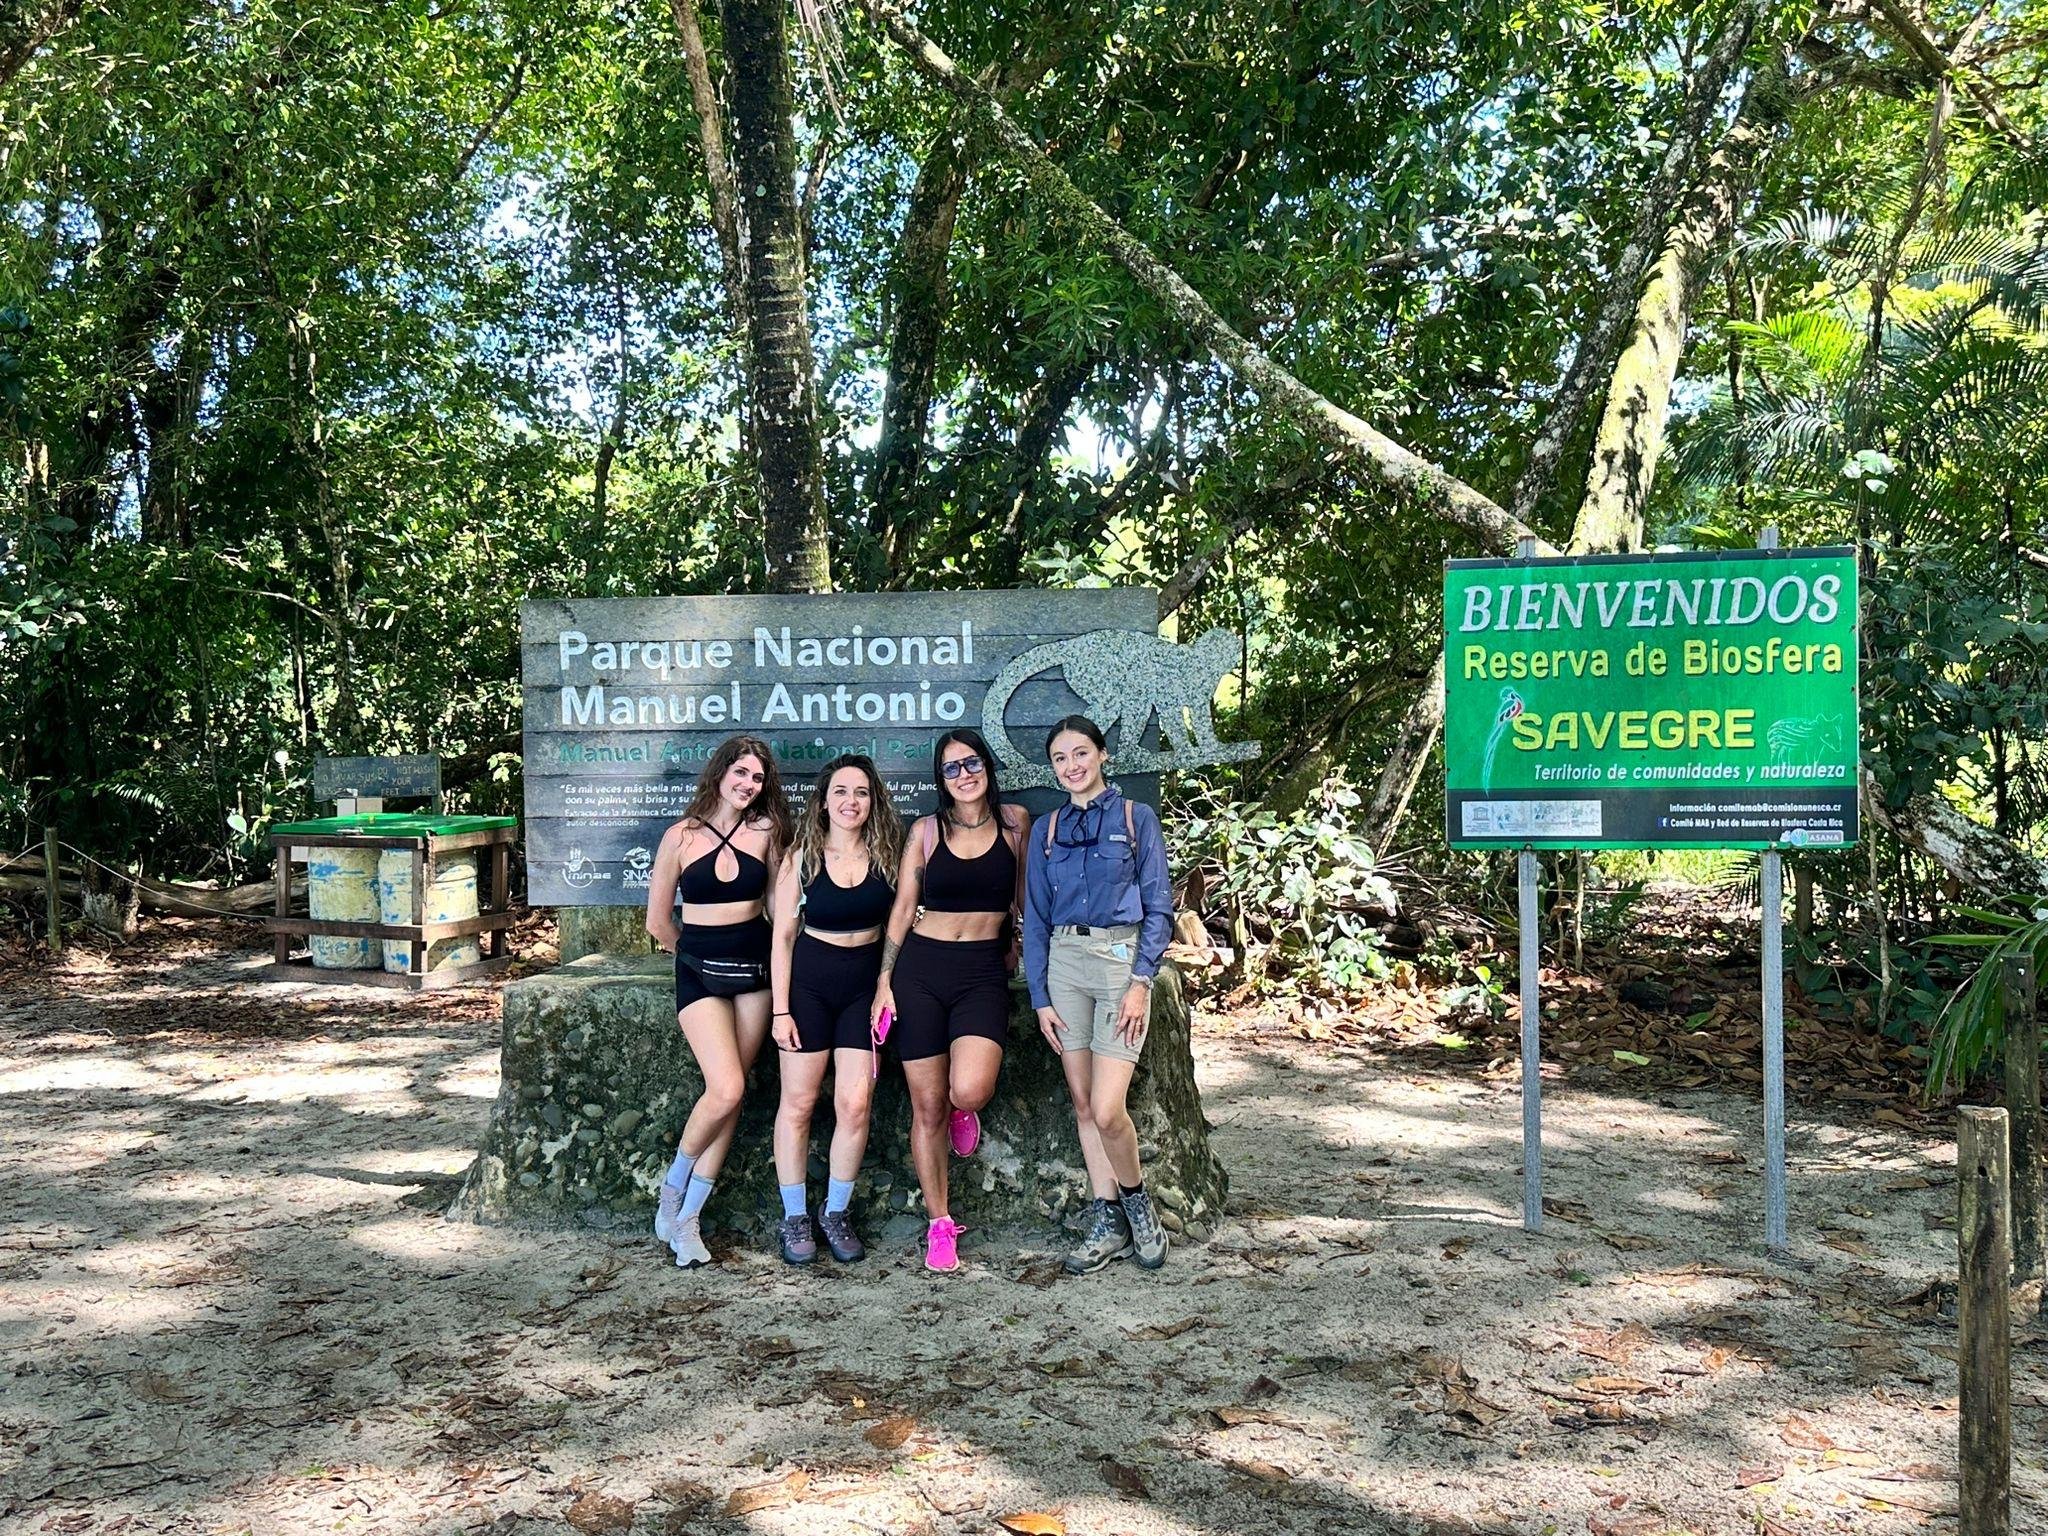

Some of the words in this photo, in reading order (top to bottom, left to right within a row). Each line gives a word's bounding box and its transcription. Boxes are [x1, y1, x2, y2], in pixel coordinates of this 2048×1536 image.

[1459, 574, 1842, 632] BIENVENIDOS
[559, 630, 733, 681] Parque
[753, 620, 973, 667] Nacional
[1464, 645, 1609, 679] Reserva
[1625, 640, 1667, 676] de
[1684, 637, 1842, 675] Biosfera
[561, 680, 741, 725] Manuel
[761, 680, 966, 722] Antonio
[1511, 708, 1755, 750] SAVEGRE
[559, 740, 649, 763] Manuel
[660, 740, 717, 763] Anto
[769, 736, 876, 760] National
[1534, 763, 1601, 781] Territorio
[1607, 763, 1627, 780] de
[1632, 762, 1740, 780] comunidades
[1746, 766, 1755, 783] y
[1760, 763, 1845, 779] naturaleza
[578, 784, 593, 793] mil
[595, 785, 621, 794] veces
[623, 783, 643, 793] más
[645, 783, 668, 793] bella
[671, 783, 683, 793] mi
[685, 783, 698, 793] tie
[901, 783, 915, 793] my
[632, 796, 643, 804] su
[645, 794, 668, 803] brisa
[670, 796, 676, 805] y
[678, 795, 689, 803] su
[599, 808, 609, 817] de
[612, 808, 619, 817] la
[660, 807, 684, 816] Costa
[1669, 802, 1716, 812] Información
[566, 819, 587, 827] autor
[589, 818, 639, 827] desconocido
[1670, 817, 1694, 827] Comité
[1695, 818, 1710, 827] MAB
[1716, 818, 1729, 827] Red
[1730, 818, 1739, 827] de
[1741, 818, 1770, 827] Reservas
[1771, 818, 1780, 827] de
[1781, 817, 1807, 827] Biosfera
[1808, 817, 1827, 827] Costa
[1828, 817, 1843, 827] Rica
[1809, 833, 1839, 842] ASANA
